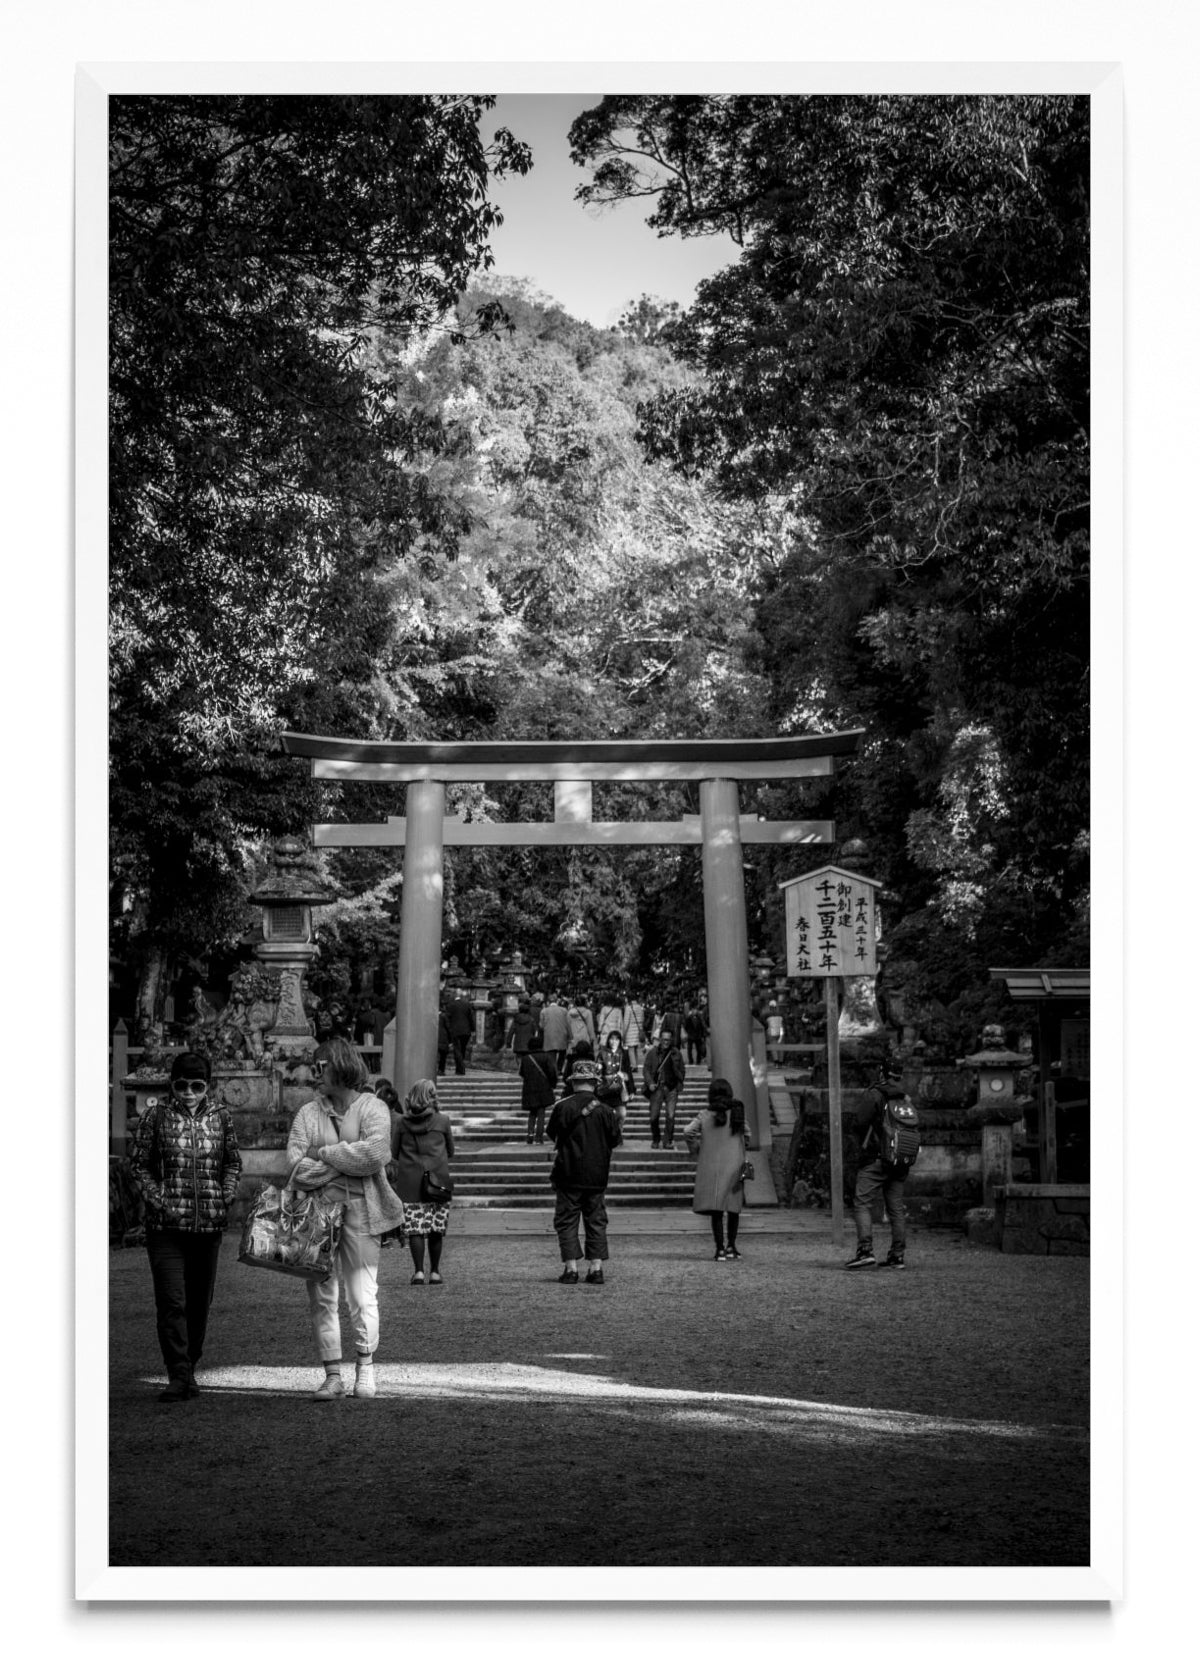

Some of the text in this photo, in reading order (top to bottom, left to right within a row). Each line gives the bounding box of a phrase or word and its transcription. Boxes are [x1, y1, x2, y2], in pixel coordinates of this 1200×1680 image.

[815, 880, 838, 971] 千二百五十年
[837, 881, 852, 928] 御創建
[855, 897, 868, 961] 平成三十年
[795, 916, 812, 971] 春日大社
